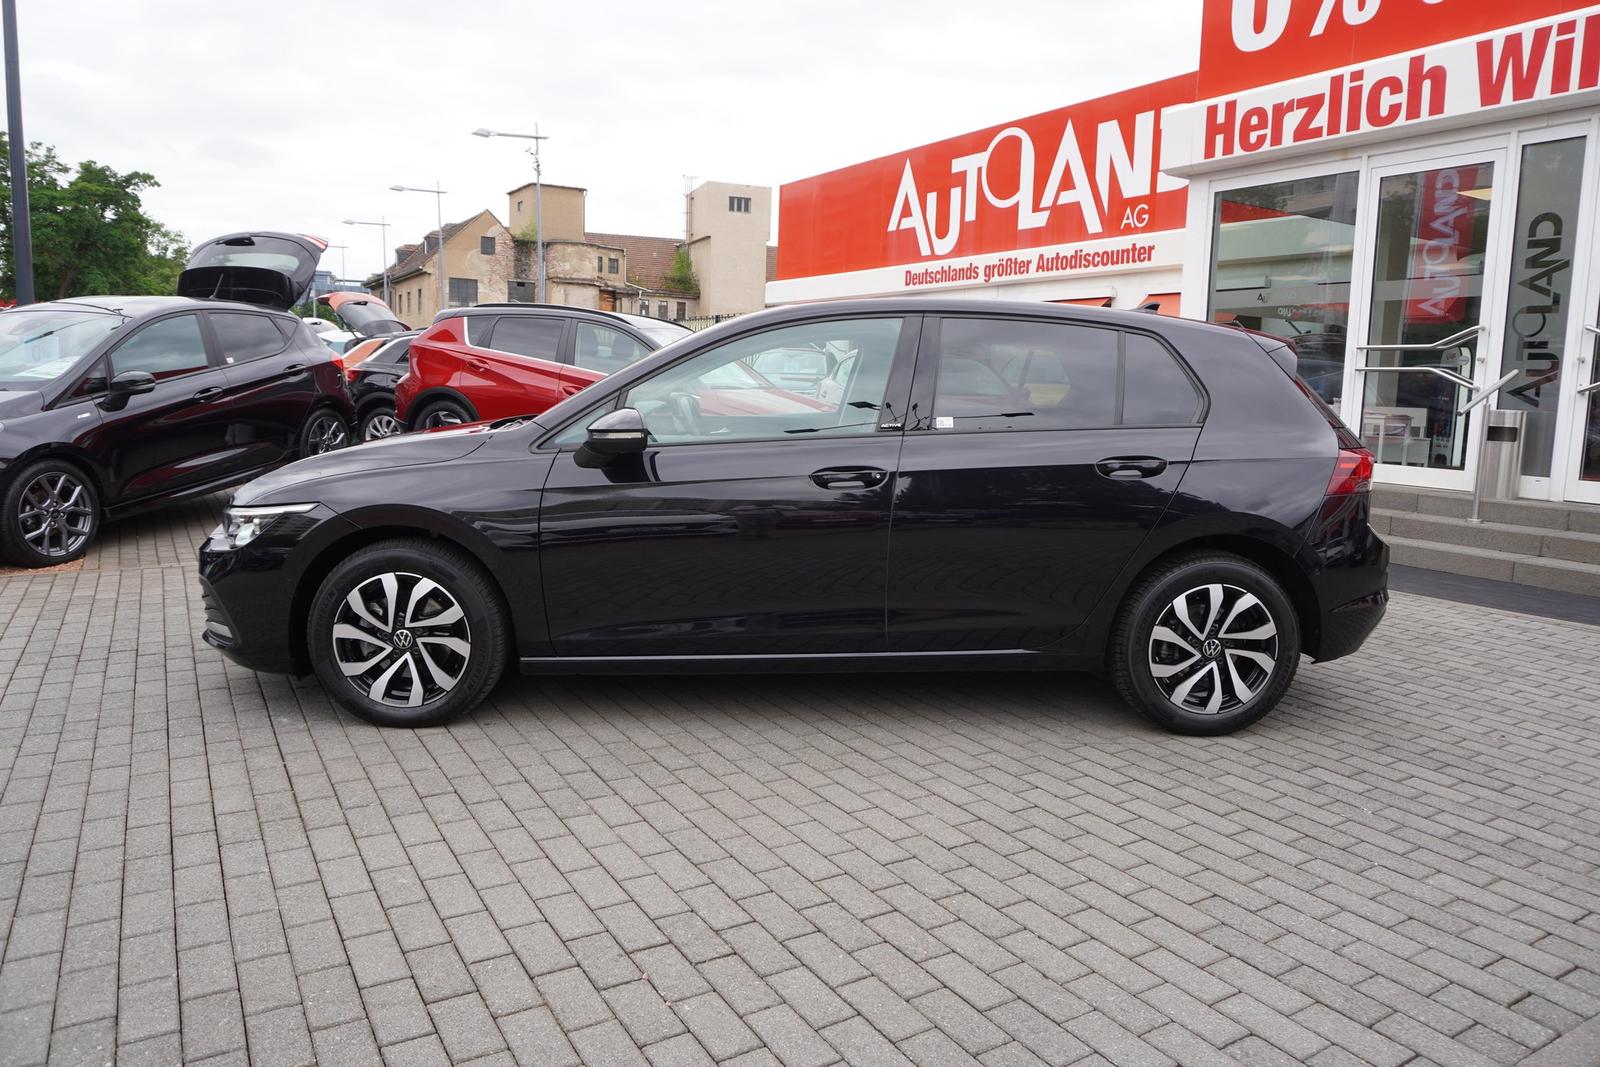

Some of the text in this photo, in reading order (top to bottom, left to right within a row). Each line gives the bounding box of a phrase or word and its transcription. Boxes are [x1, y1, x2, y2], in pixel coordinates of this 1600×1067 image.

[1204, 55, 1447, 160] Herzlich
[905, 243, 1156, 287] Deutschlands größter Autodiscounter
[1120, 203, 1149, 230] AG
[1416, 168, 1468, 317] AUTOLAND
[1506, 212, 1570, 408] AUTOLAND
